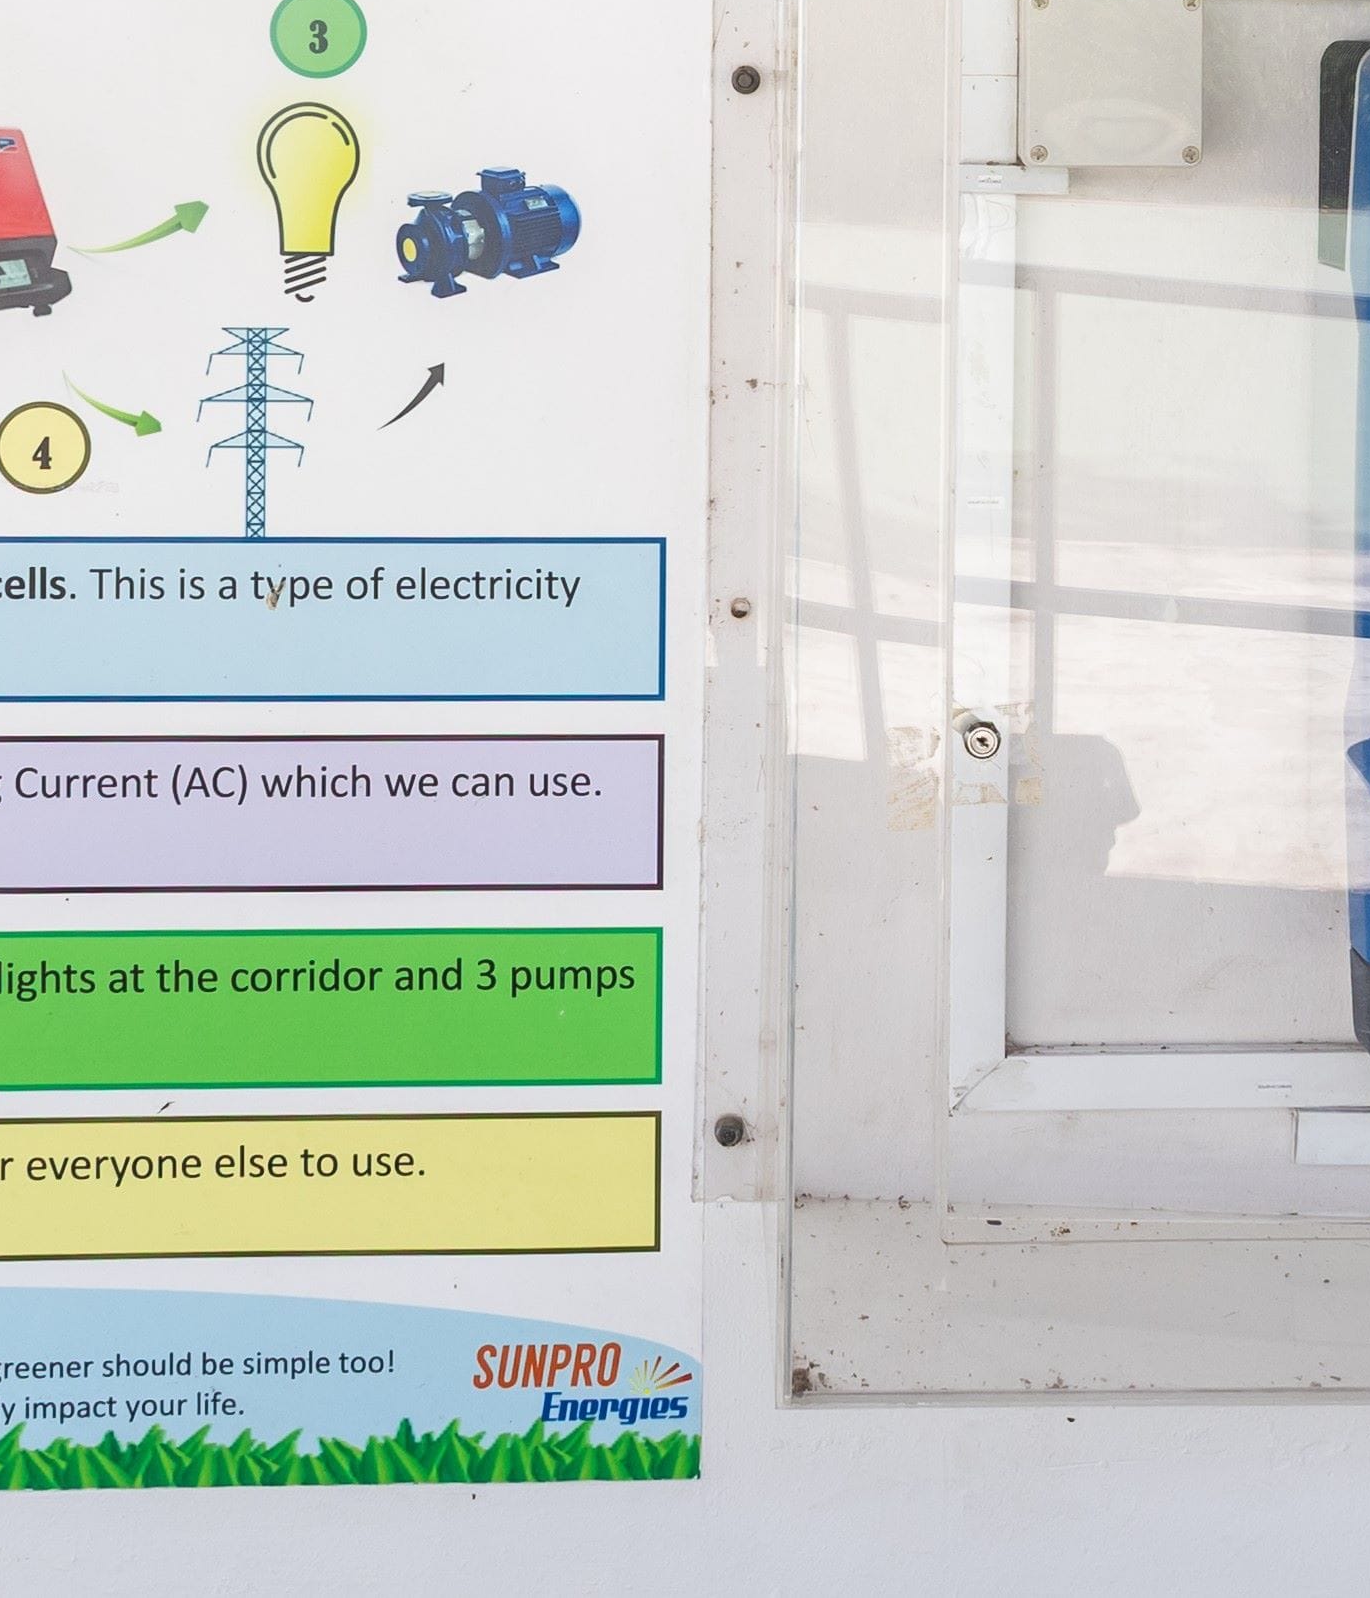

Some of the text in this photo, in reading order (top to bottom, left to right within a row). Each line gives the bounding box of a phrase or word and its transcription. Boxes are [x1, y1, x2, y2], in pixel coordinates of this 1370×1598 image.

[309, 19, 330, 55] 3
[32, 435, 52, 471] 4
[90, 567, 164, 599] This
[180, 569, 204, 599] is
[219, 577, 236, 599] a
[251, 572, 332, 607] type
[347, 567, 385, 599] of
[397, 567, 580, 607] electricity
[16, 768, 158, 798] Current
[172, 765, 247, 805] (AC)
[262, 765, 370, 797] which
[385, 774, 438, 797] we
[452, 774, 513, 797] can
[530, 773, 600, 796] use.
[103, 1352, 191, 1377] should
[203, 1352, 233, 1375] be
[243, 1350, 330, 1379] simple
[339, 1350, 393, 1373] too!
[473, 1342, 622, 1390] SUNPRO
[541, 1391, 690, 1426] Energies
